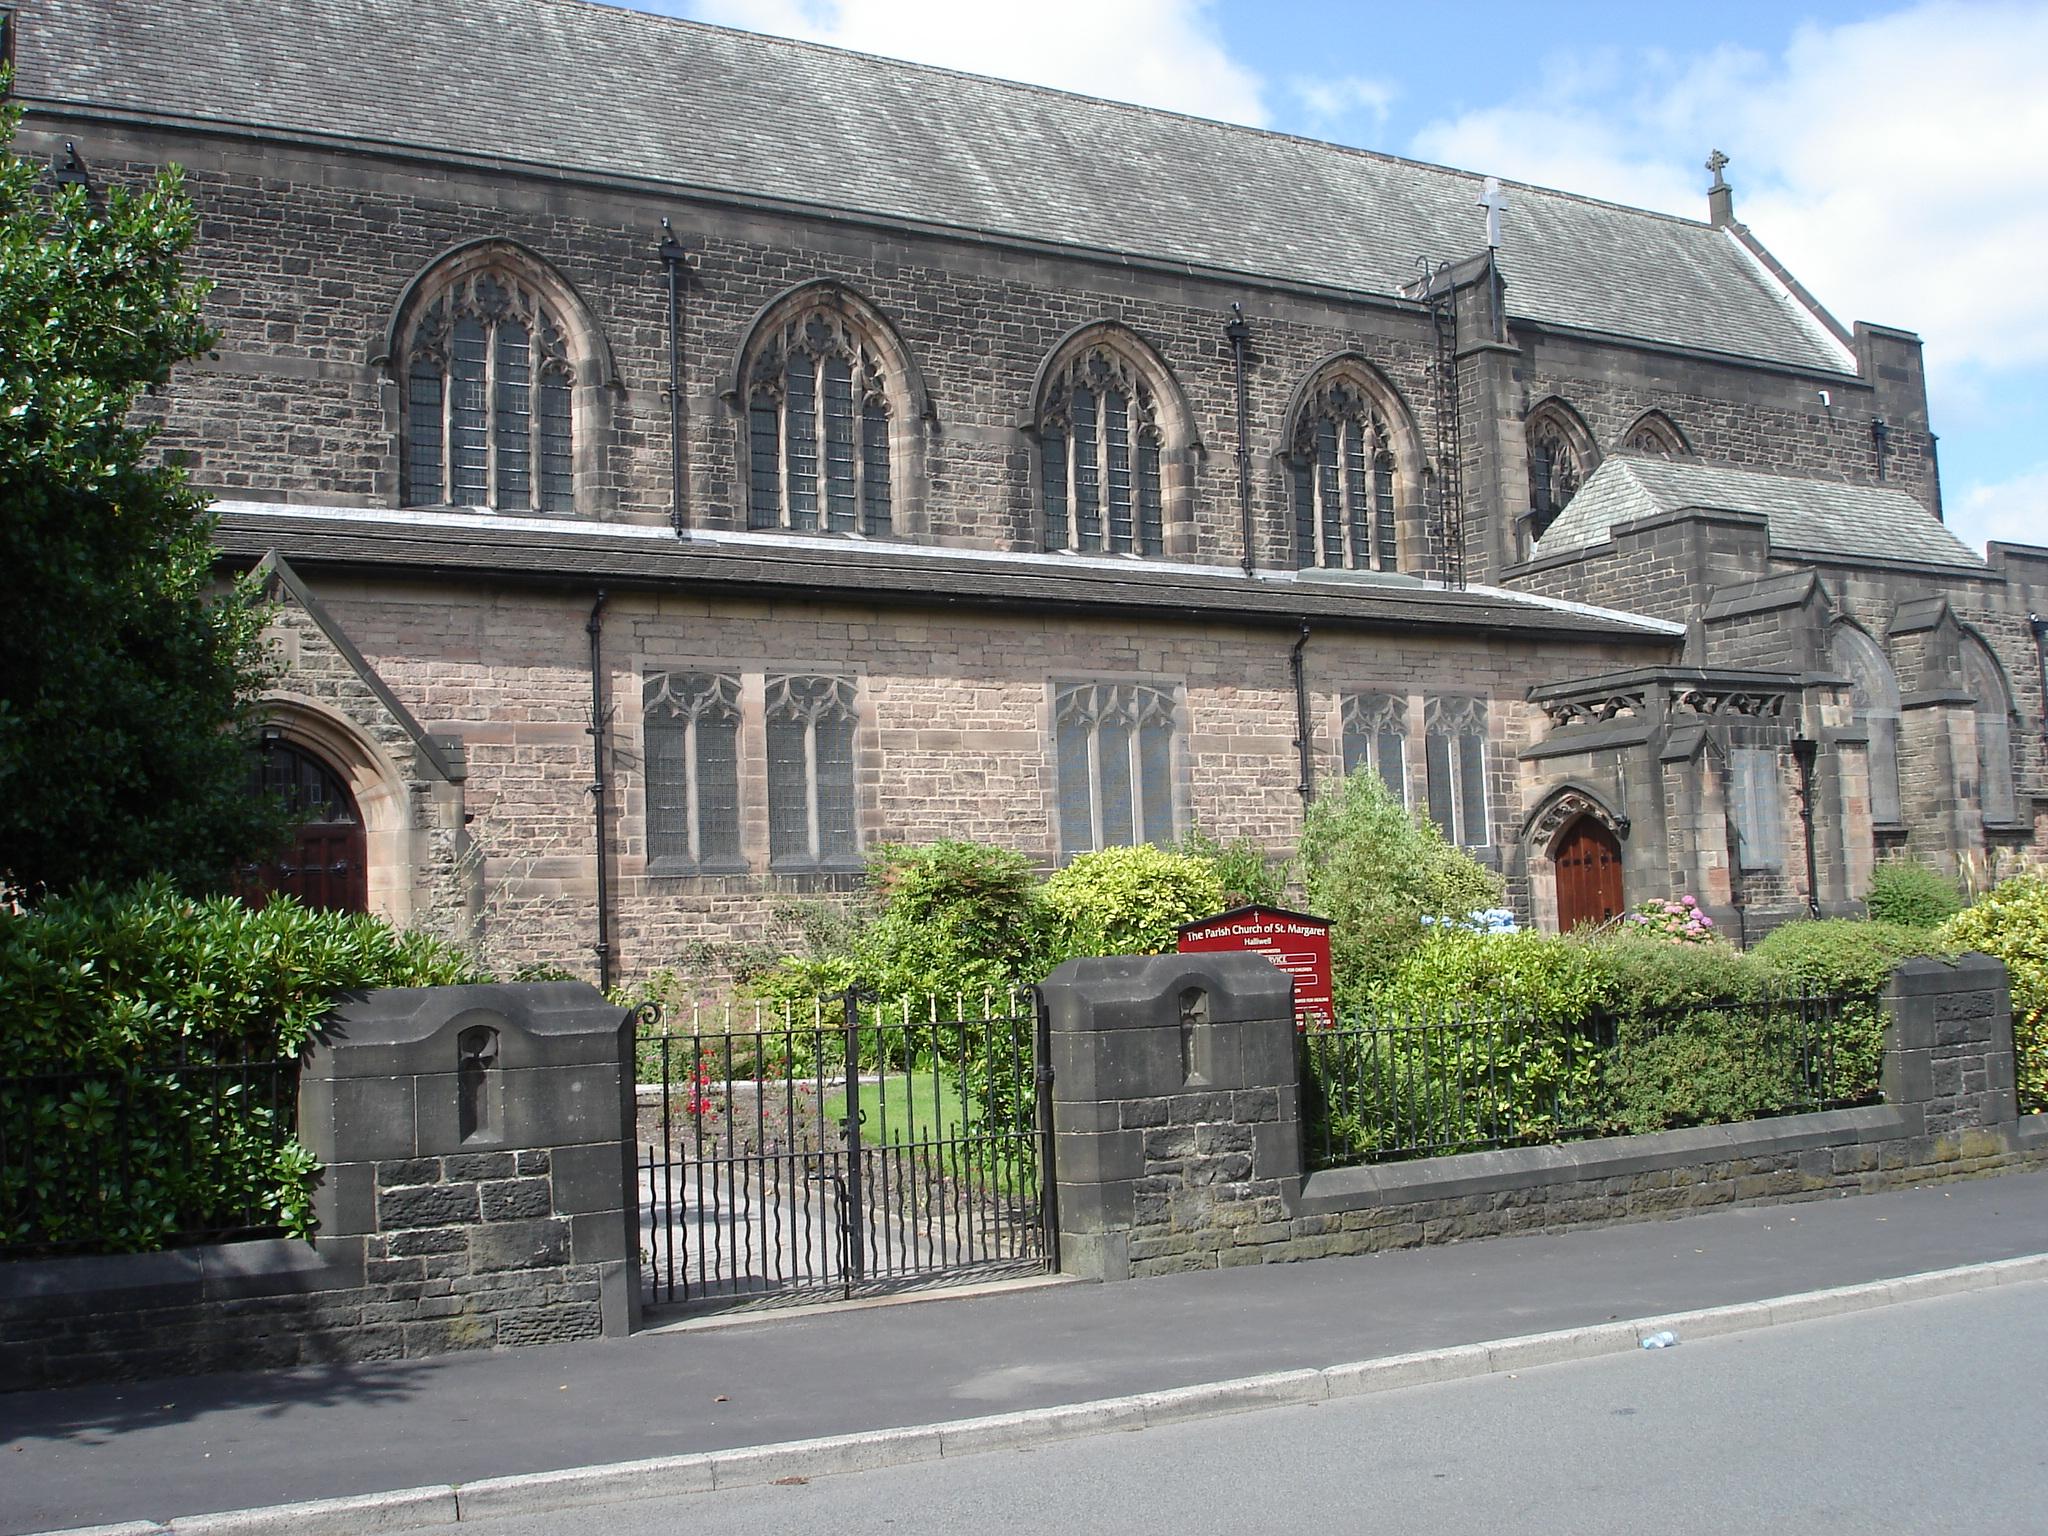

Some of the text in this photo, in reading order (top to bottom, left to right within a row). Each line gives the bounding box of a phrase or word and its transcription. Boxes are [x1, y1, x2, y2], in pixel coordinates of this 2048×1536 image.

[1186, 931, 1204, 942] The
[1205, 926, 1231, 939] Parish
[1232, 923, 1263, 935] Church
[1264, 923, 1274, 933] of
[1287, 923, 1326, 937] Margaret
